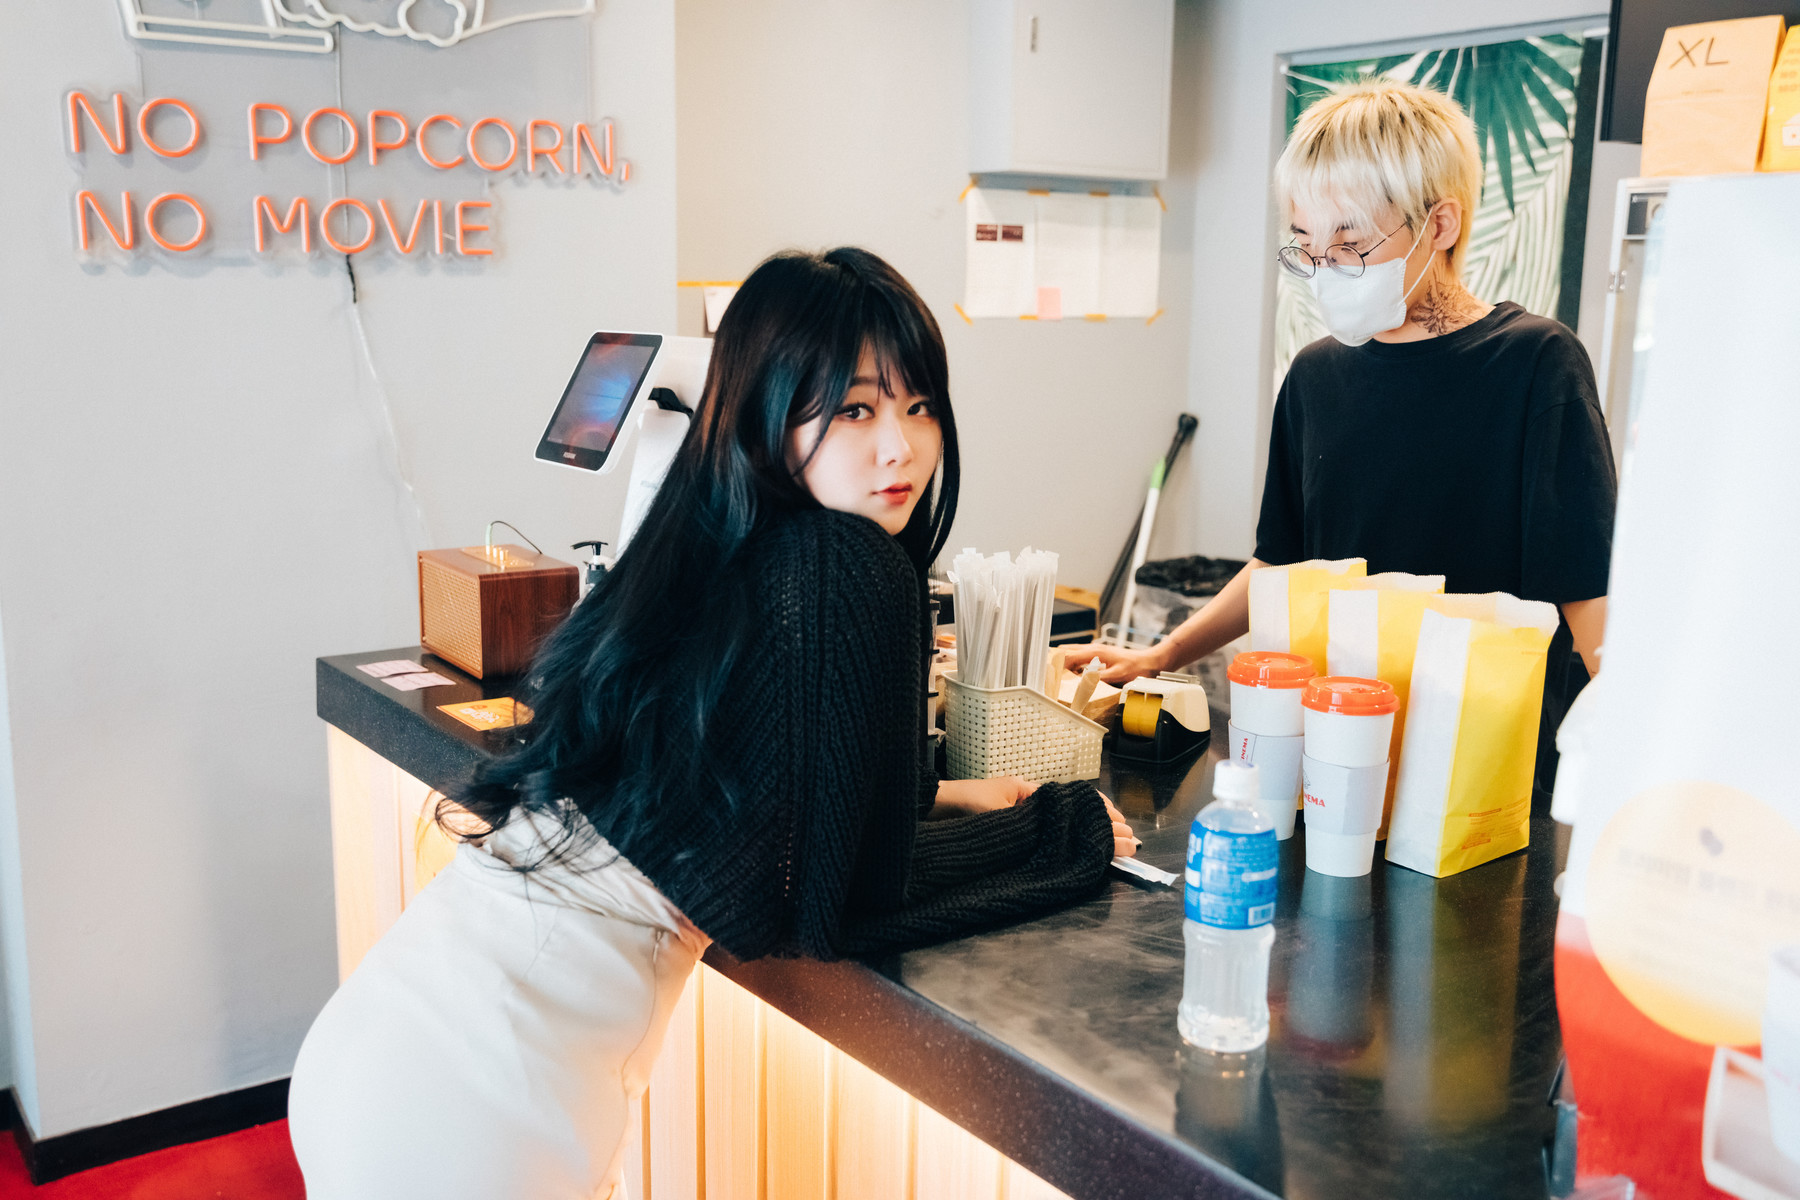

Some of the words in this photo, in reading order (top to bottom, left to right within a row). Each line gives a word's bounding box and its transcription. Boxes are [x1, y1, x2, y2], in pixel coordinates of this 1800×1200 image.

[1668, 36, 1731, 70] XL
[66, 91, 201, 159] NO
[248, 102, 631, 182] POPCORN,
[76, 190, 207, 253] NO
[253, 195, 495, 257] MOVIE
[1240, 737, 1249, 761] INEMA
